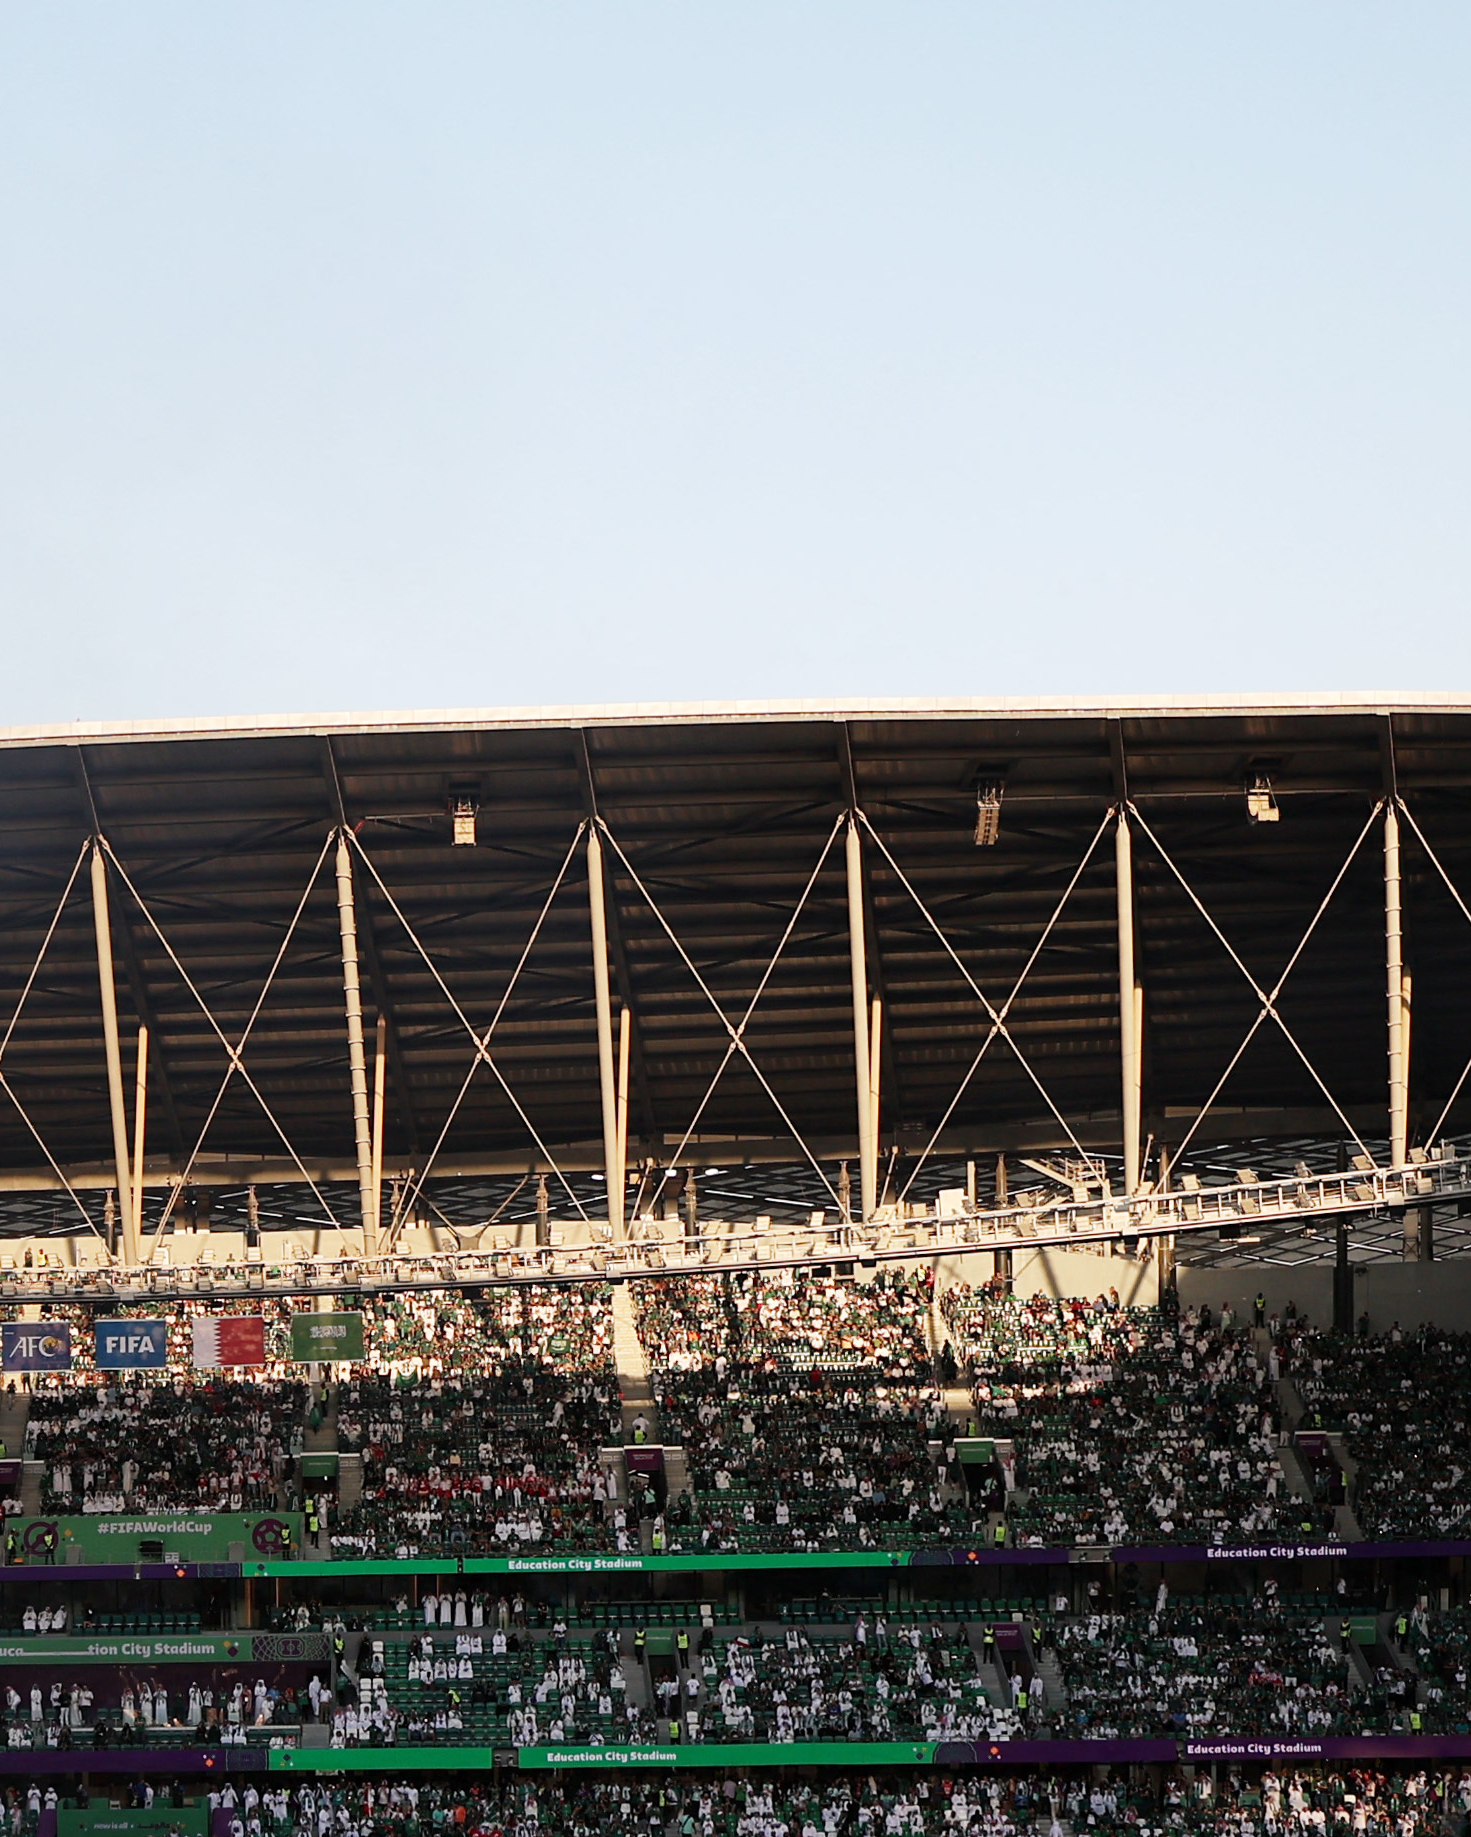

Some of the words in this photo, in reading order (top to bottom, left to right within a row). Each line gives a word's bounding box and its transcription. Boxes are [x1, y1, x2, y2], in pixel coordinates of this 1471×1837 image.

[9, 1335, 56, 1358] AFC
[105, 1335, 156, 1354] FIFA
[97, 1521, 213, 1535] #FIFAWorldCup
[1207, 1547, 1268, 1558] Education
[1269, 1547, 1295, 1559] City
[1296, 1546, 1347, 1556] Stadium
[508, 1559, 566, 1570] Education
[567, 1559, 592, 1571] City
[593, 1558, 642, 1569] Stadium
[121, 1642, 152, 1659] City
[154, 1641, 215, 1655] Stadium
[1186, 1744, 1245, 1755] Education
[1247, 1743, 1271, 1755] City
[1273, 1743, 1322, 1753] Stadium
[546, 1752, 603, 1762] Education
[605, 1751, 628, 1763] City
[630, 1750, 677, 1761] Stadium
